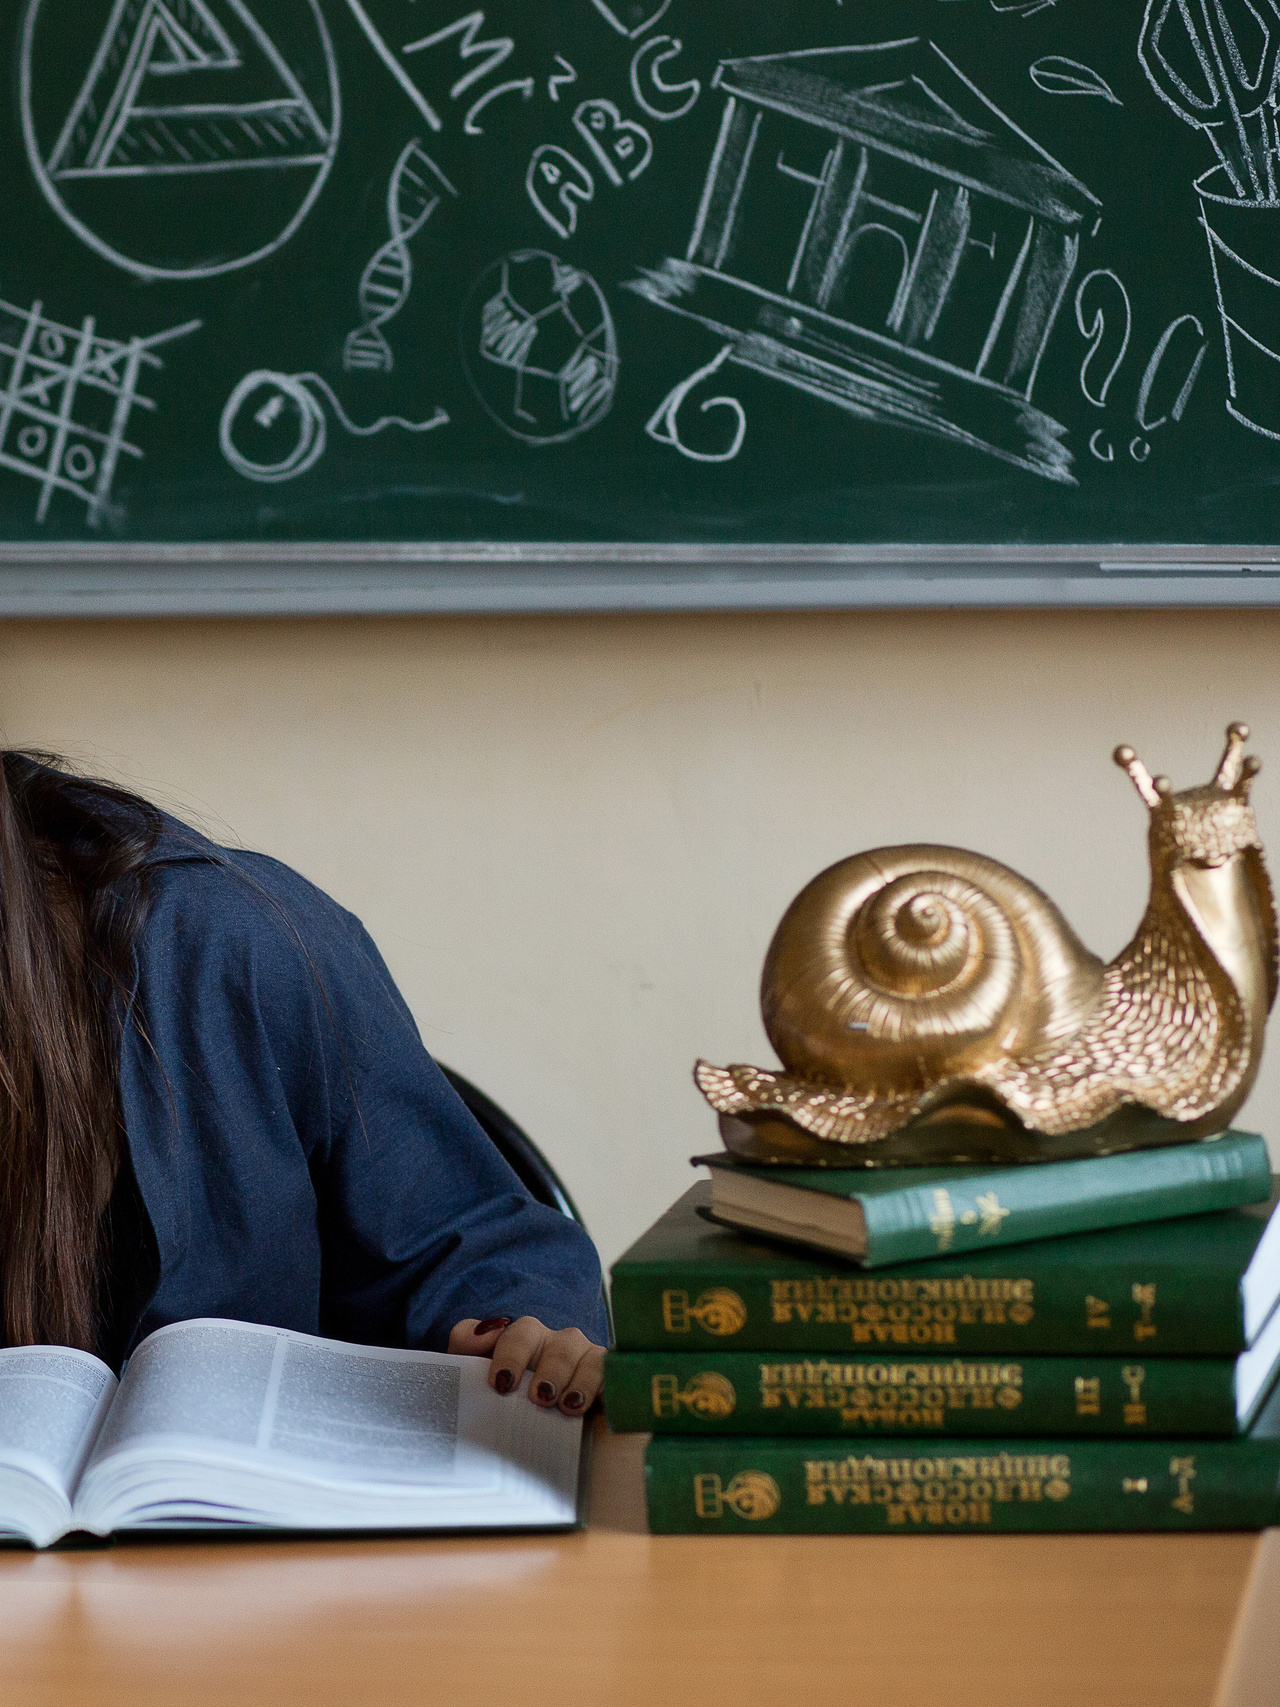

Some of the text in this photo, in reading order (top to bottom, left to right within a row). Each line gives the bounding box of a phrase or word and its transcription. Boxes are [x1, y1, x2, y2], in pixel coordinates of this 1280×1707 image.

[771, 1300, 1035, 1325] ФИЛОСОФСКАЯ
[852, 1322, 958, 1344] НОВАЯ
[761, 1386, 1023, 1411] ФИЛОСОФСКАЯ
[841, 1407, 946, 1429] НОВАЯ
[805, 1478, 1072, 1505] ФИЛОСОФСКАЯ
[886, 1501, 992, 1525] НОВАЯ
